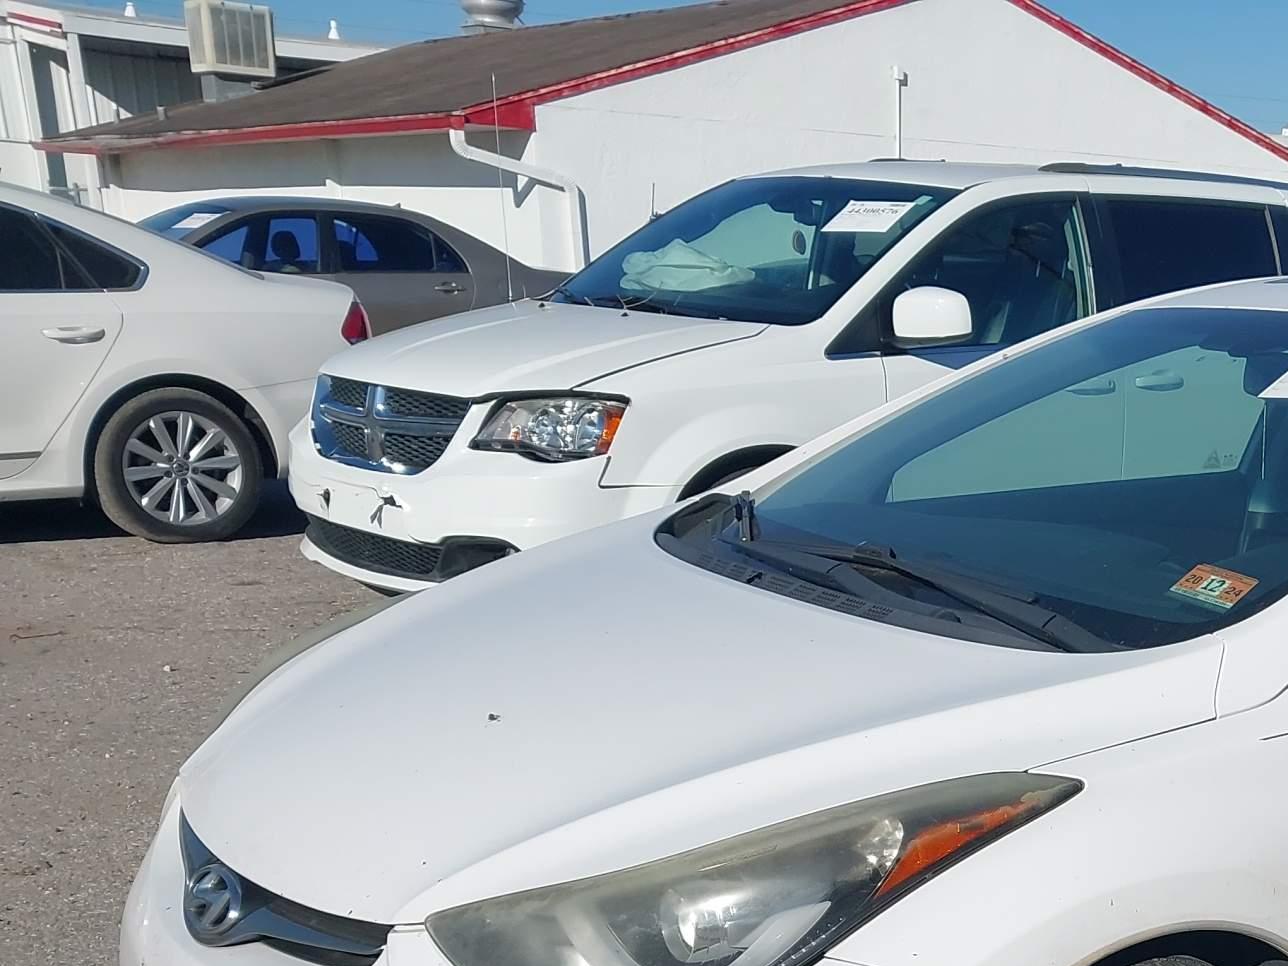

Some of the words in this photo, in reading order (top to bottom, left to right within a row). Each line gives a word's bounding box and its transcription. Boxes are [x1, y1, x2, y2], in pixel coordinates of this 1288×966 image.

[1185, 574, 1204, 585] 20
[1200, 578, 1226, 593] 12
[1224, 586, 1244, 597] 24
